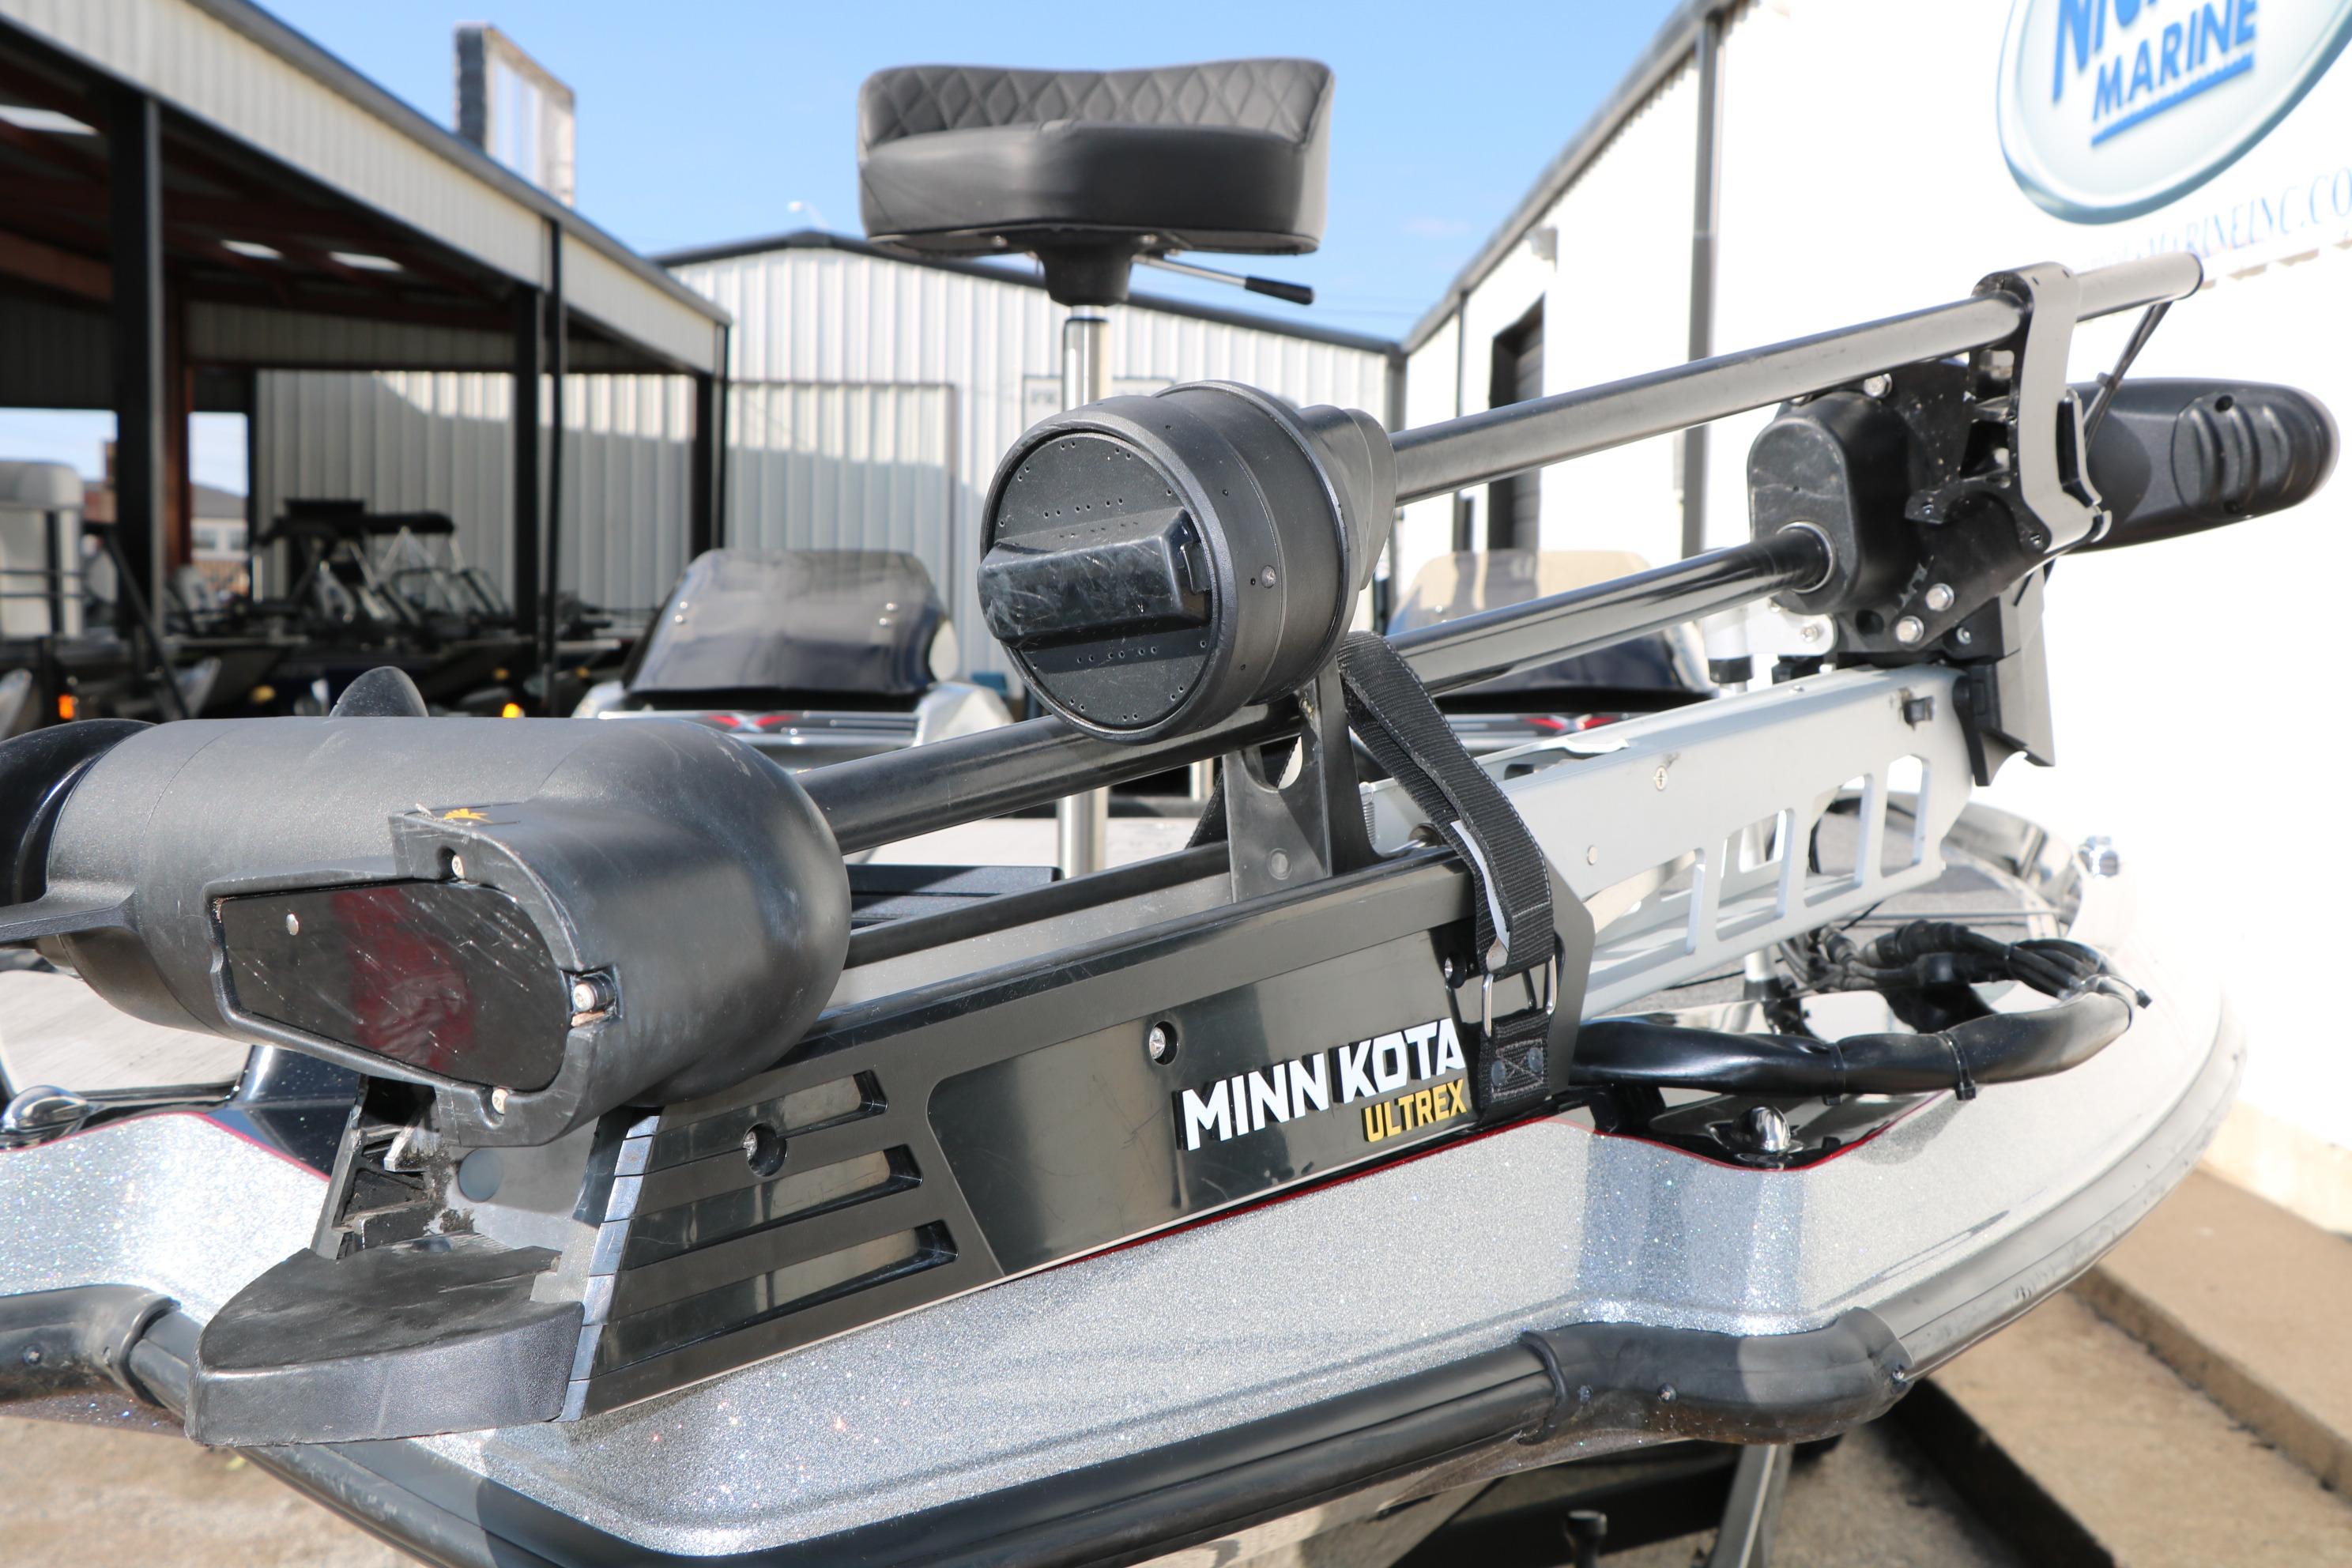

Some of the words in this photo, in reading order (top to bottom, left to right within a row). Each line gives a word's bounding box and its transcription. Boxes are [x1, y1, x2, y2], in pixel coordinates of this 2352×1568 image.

[2093, 0, 2258, 122] MARINE
[1182, 1052, 1329, 1152] MINN
[1338, 1017, 1468, 1104] KOTA
[1363, 1078, 1468, 1143] ULTREX
